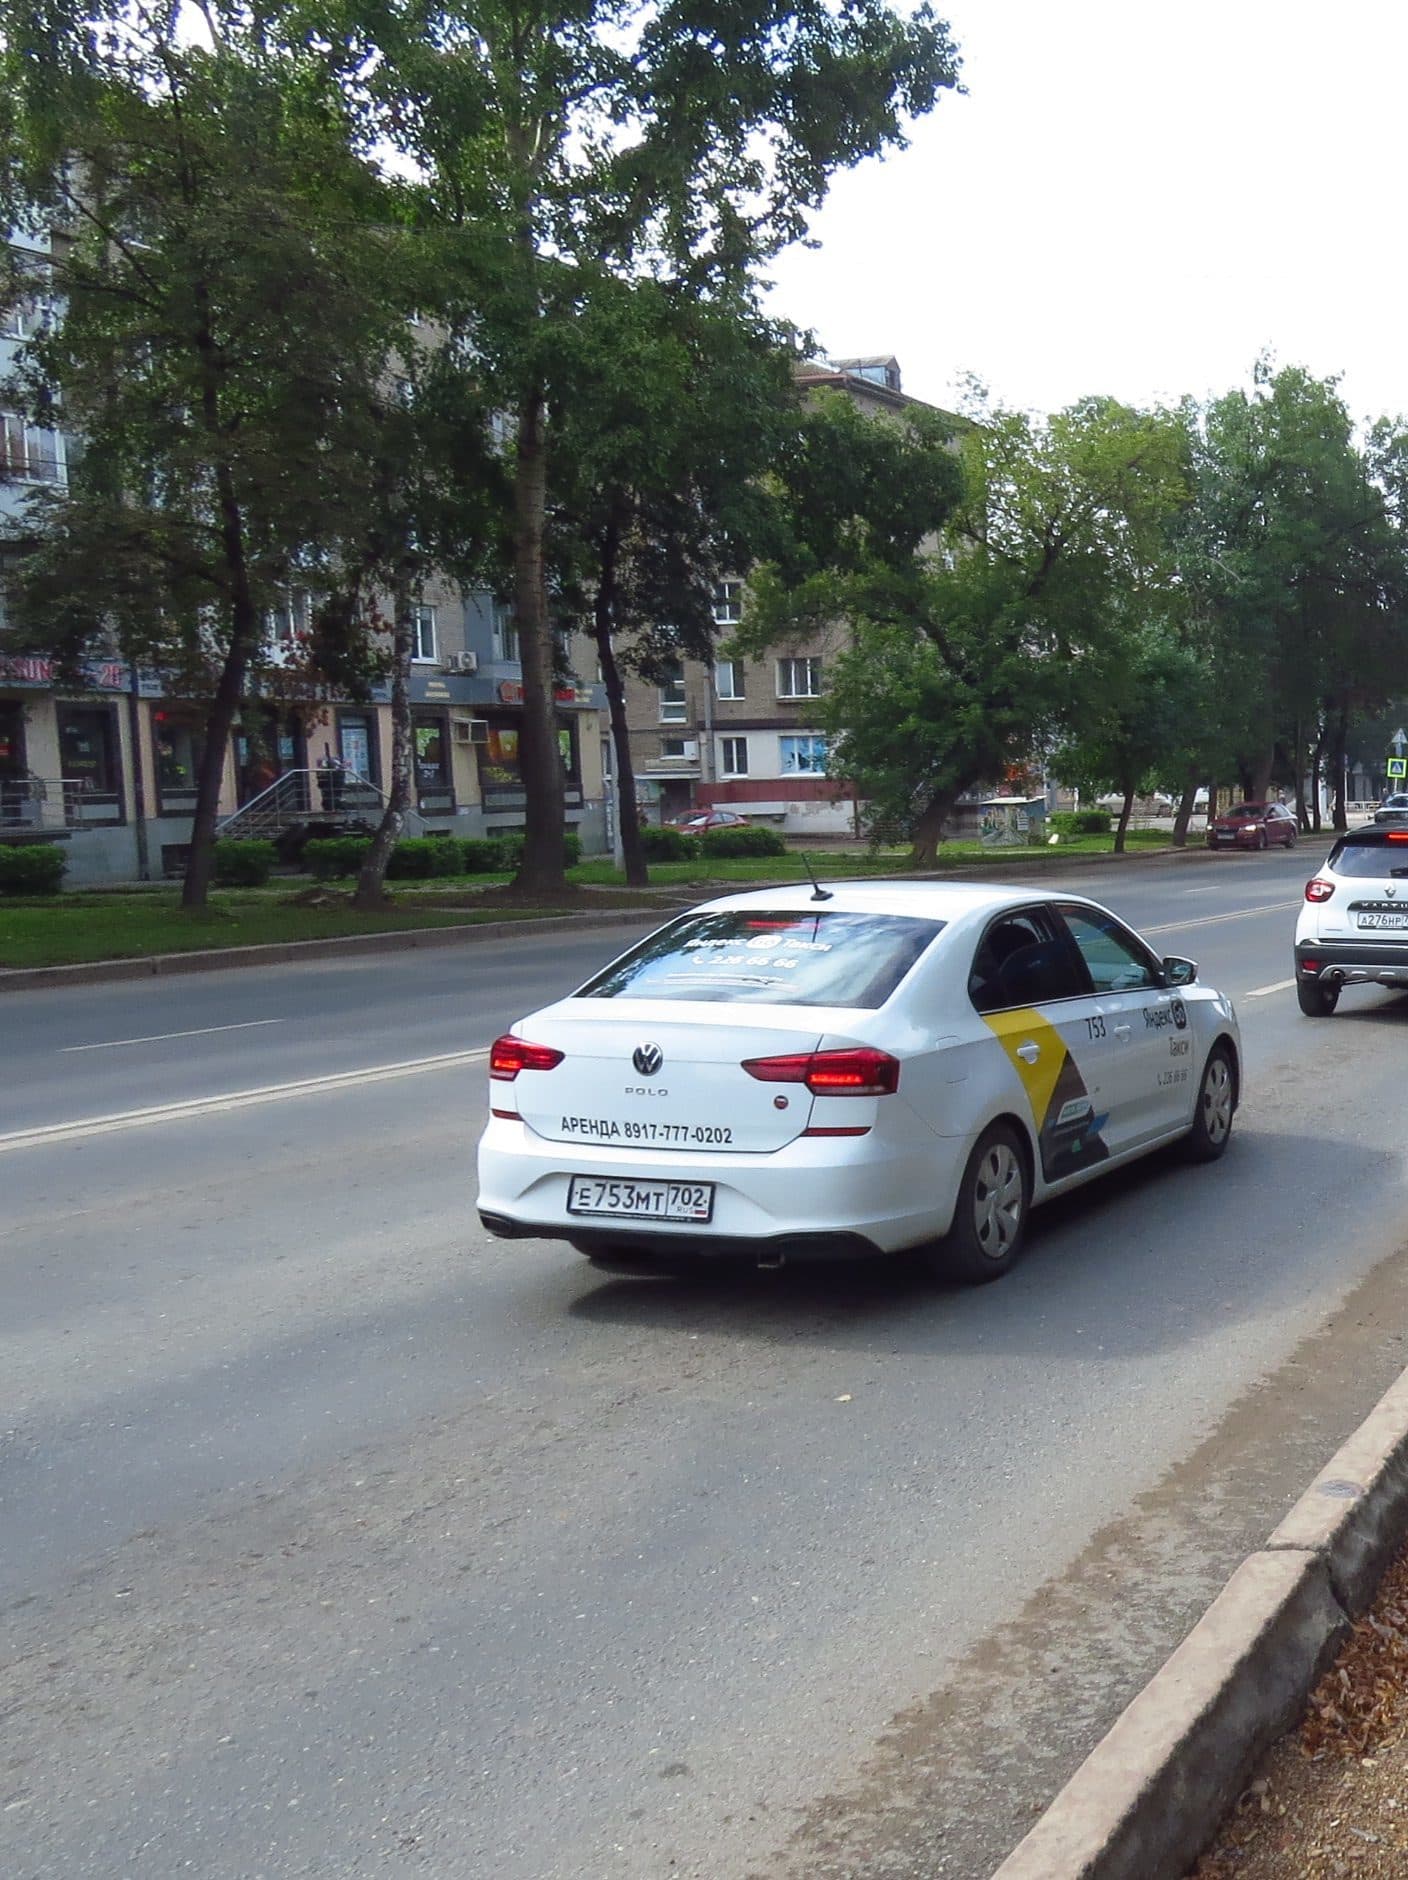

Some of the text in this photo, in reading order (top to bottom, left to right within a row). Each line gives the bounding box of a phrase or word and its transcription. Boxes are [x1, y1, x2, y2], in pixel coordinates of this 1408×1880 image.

[1085, 1015, 1107, 1039] 753
[1143, 1007, 1173, 1030] Яндекс
[624, 1087, 669, 1097] POLO
[561, 1116, 733, 1144] АРЕНДА 8917-777-0202
[670, 1186, 705, 1208] 702
